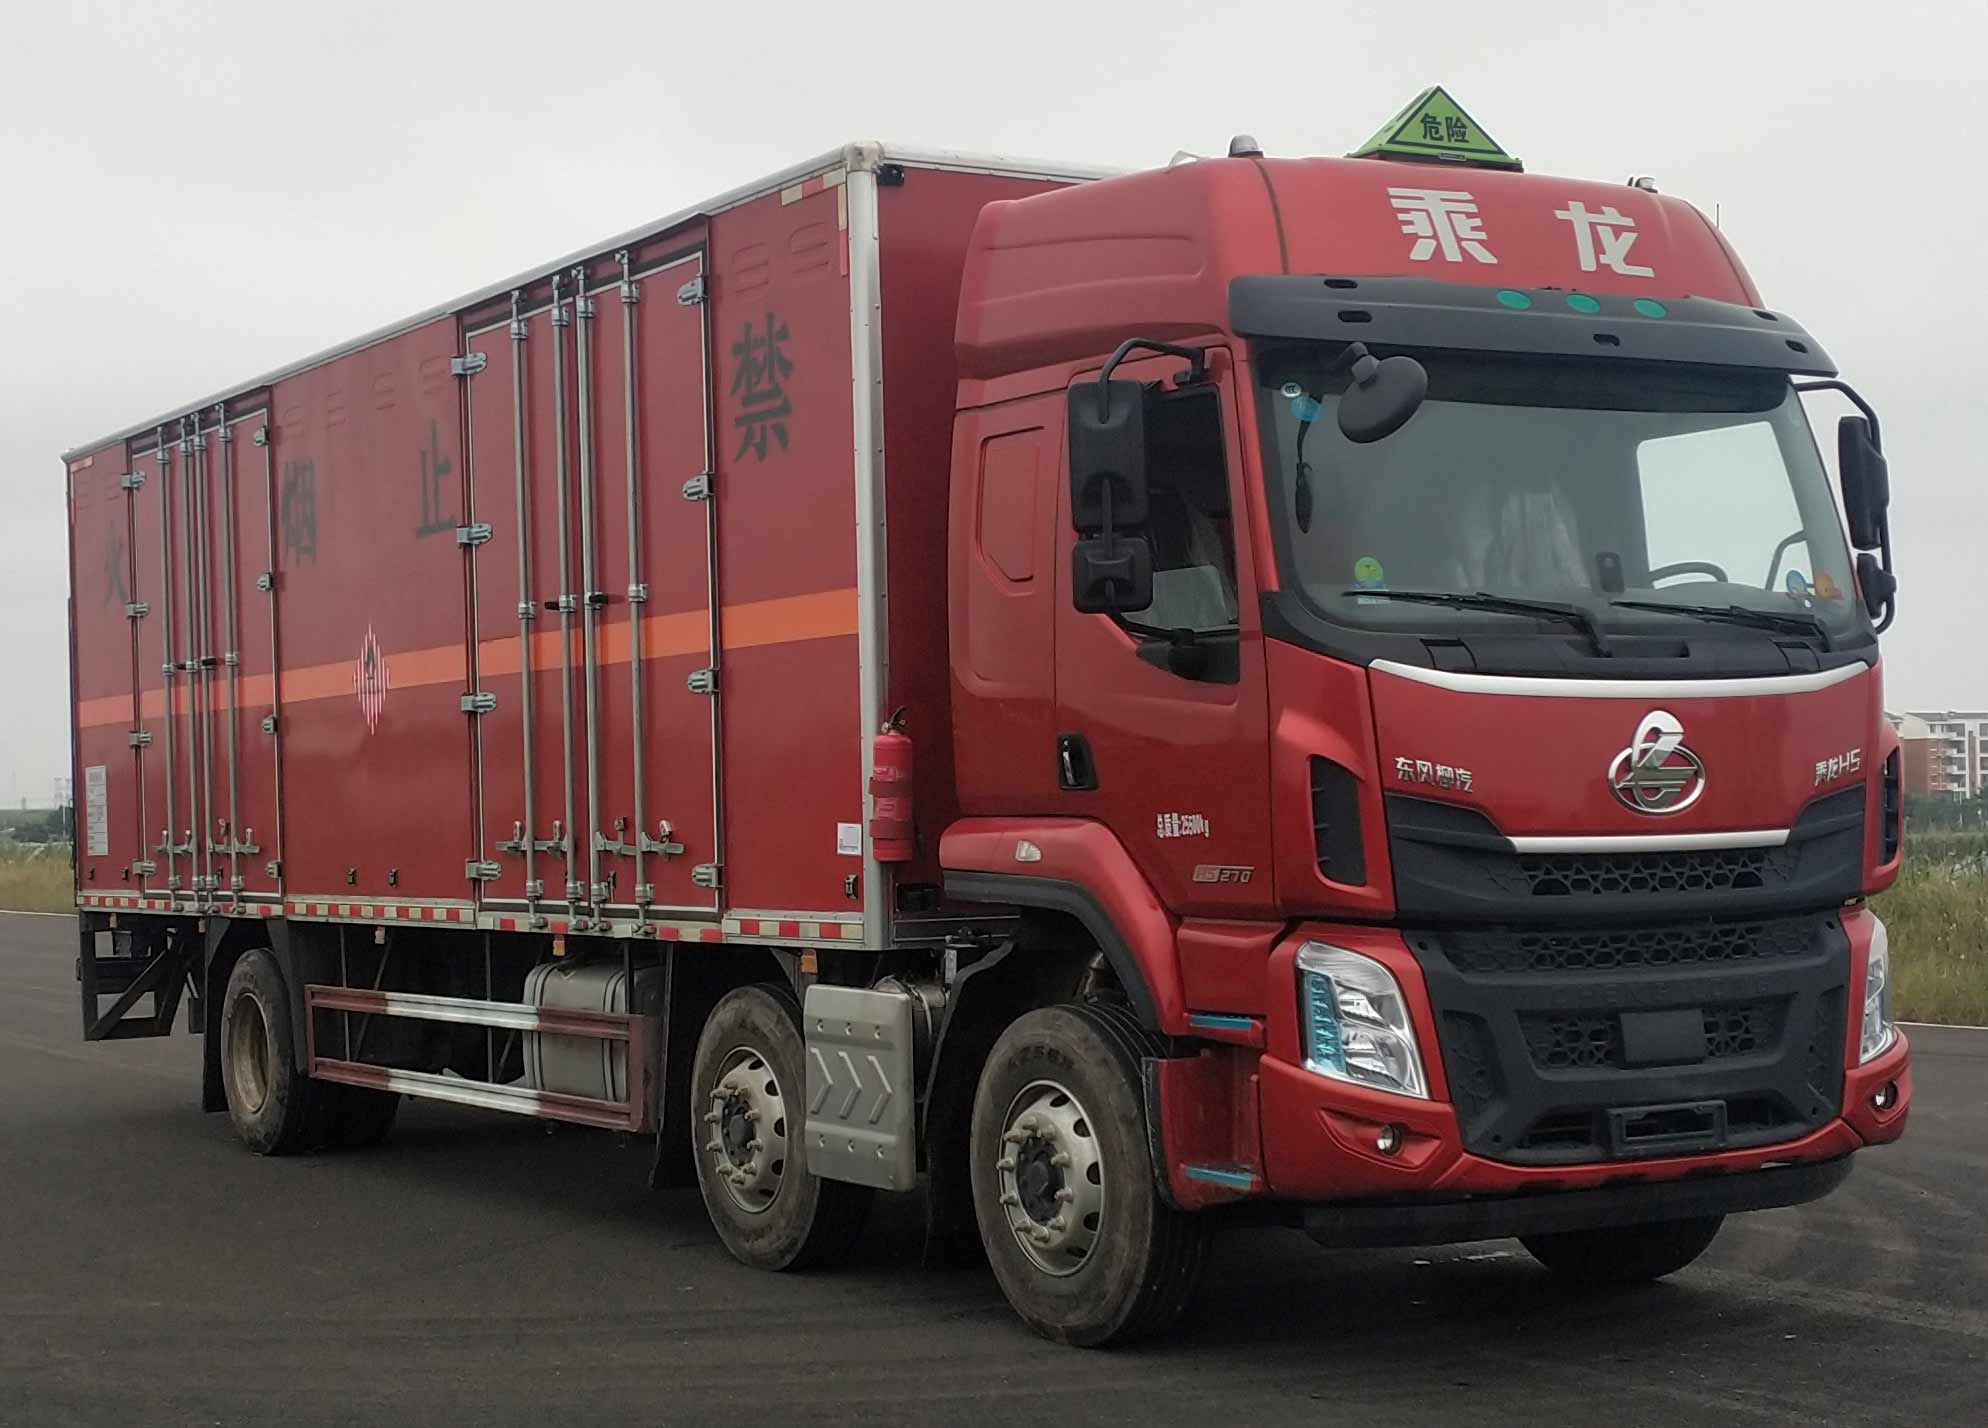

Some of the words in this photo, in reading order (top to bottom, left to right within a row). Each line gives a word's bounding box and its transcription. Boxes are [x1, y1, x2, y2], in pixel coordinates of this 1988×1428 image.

[1421, 113, 1470, 143] 危险
[1386, 187, 1655, 278] 乘龙
[730, 310, 794, 464] 禁
[415, 418, 458, 539] 止
[1220, 870, 1251, 883] 270
